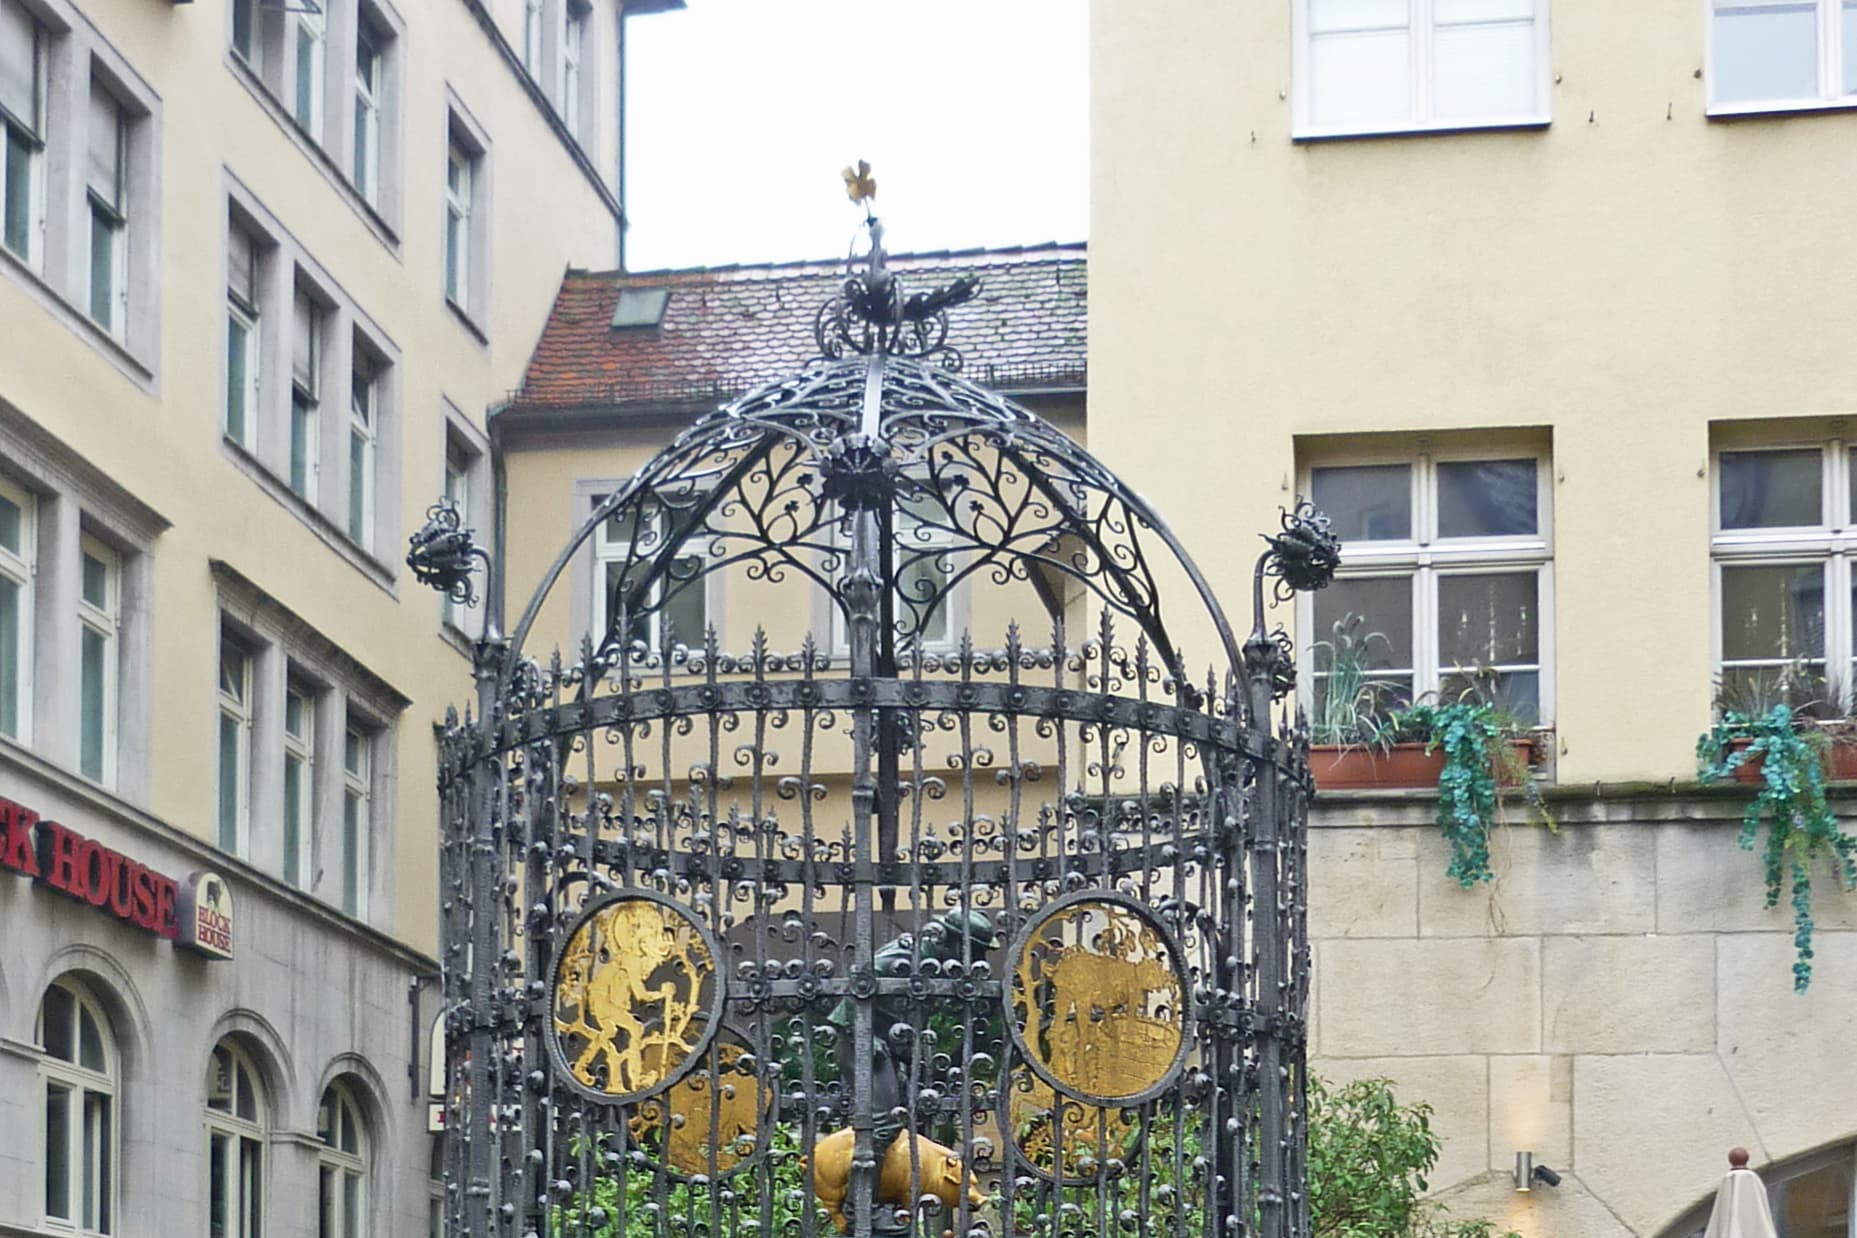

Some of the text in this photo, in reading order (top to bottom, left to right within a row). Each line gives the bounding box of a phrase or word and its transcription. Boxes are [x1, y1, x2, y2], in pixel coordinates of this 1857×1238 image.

[47, 821, 180, 940] HOUSE
[198, 904, 231, 935] BLOCK
[198, 924, 231, 954] HOUSE
